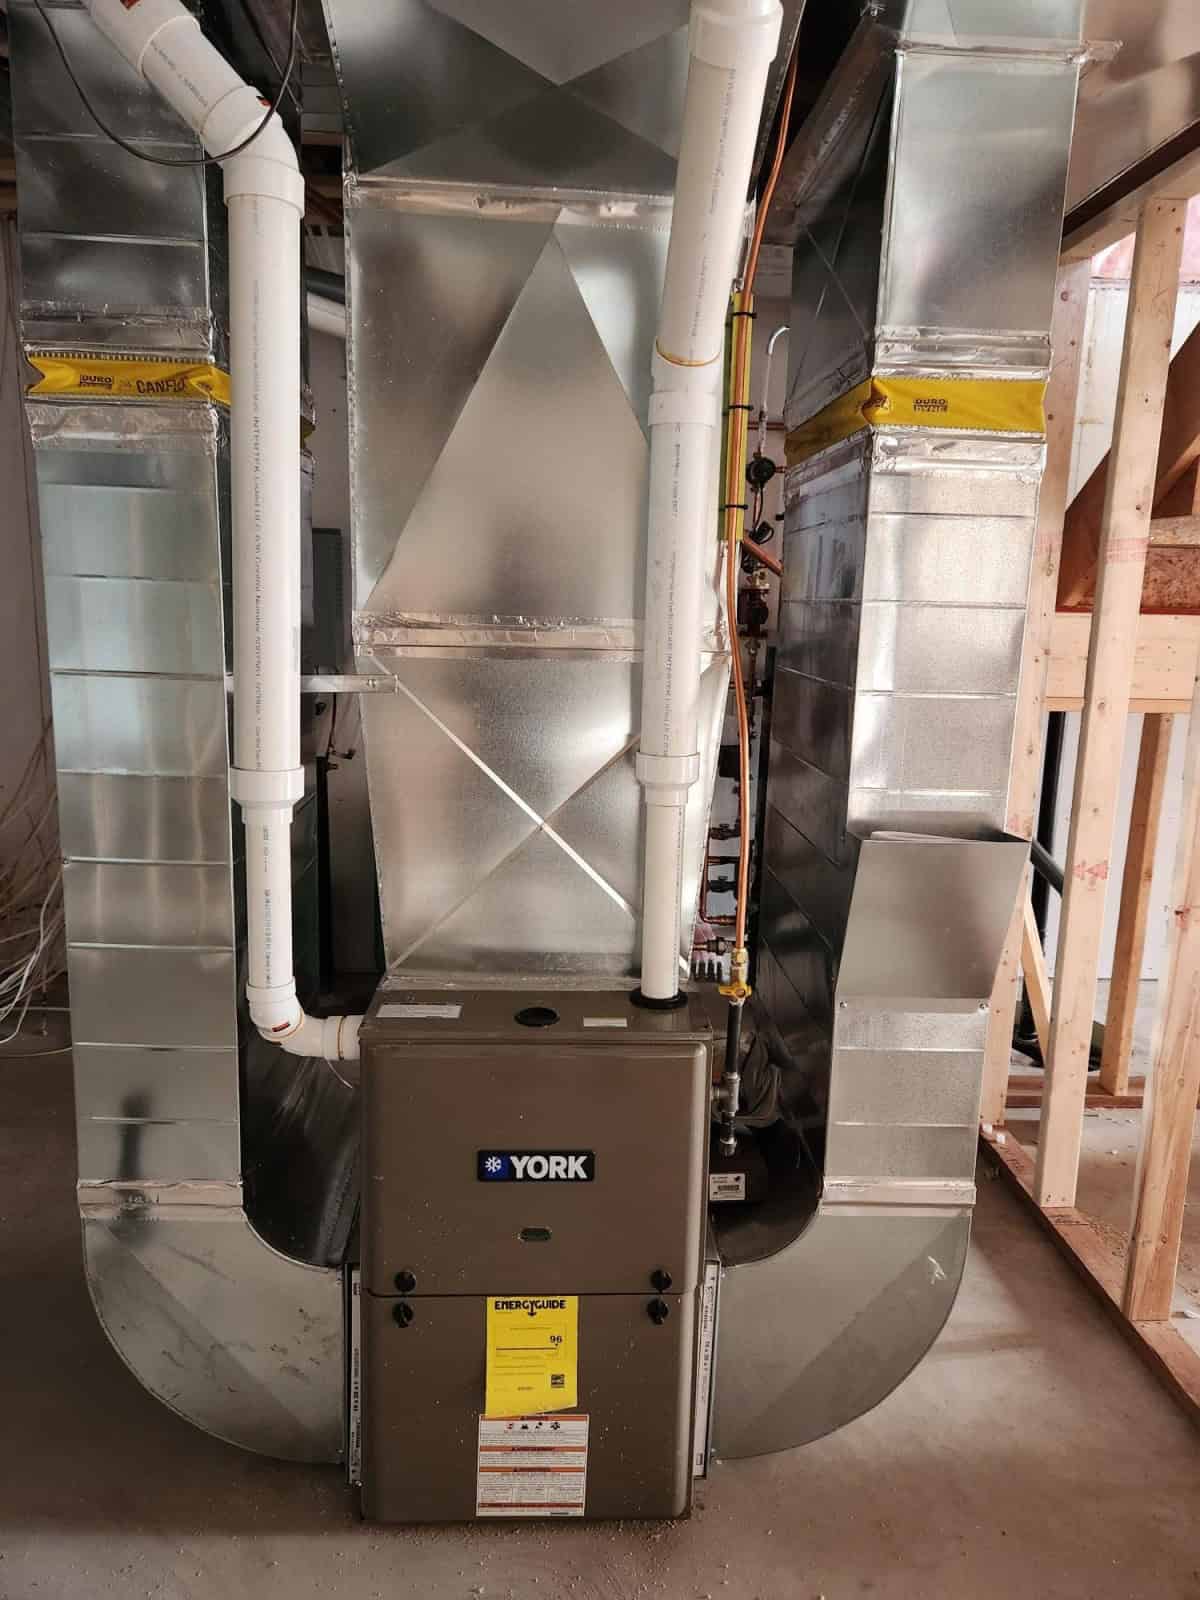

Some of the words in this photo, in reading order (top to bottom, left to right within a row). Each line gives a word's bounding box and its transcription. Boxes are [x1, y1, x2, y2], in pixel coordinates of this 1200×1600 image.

[81, 375, 113, 384] DURO
[915, 397, 946, 405] DURO
[509, 1155, 588, 1179] YORK
[494, 1299, 567, 1312] ENERGYGUIDE
[549, 1335, 562, 1343] 96
